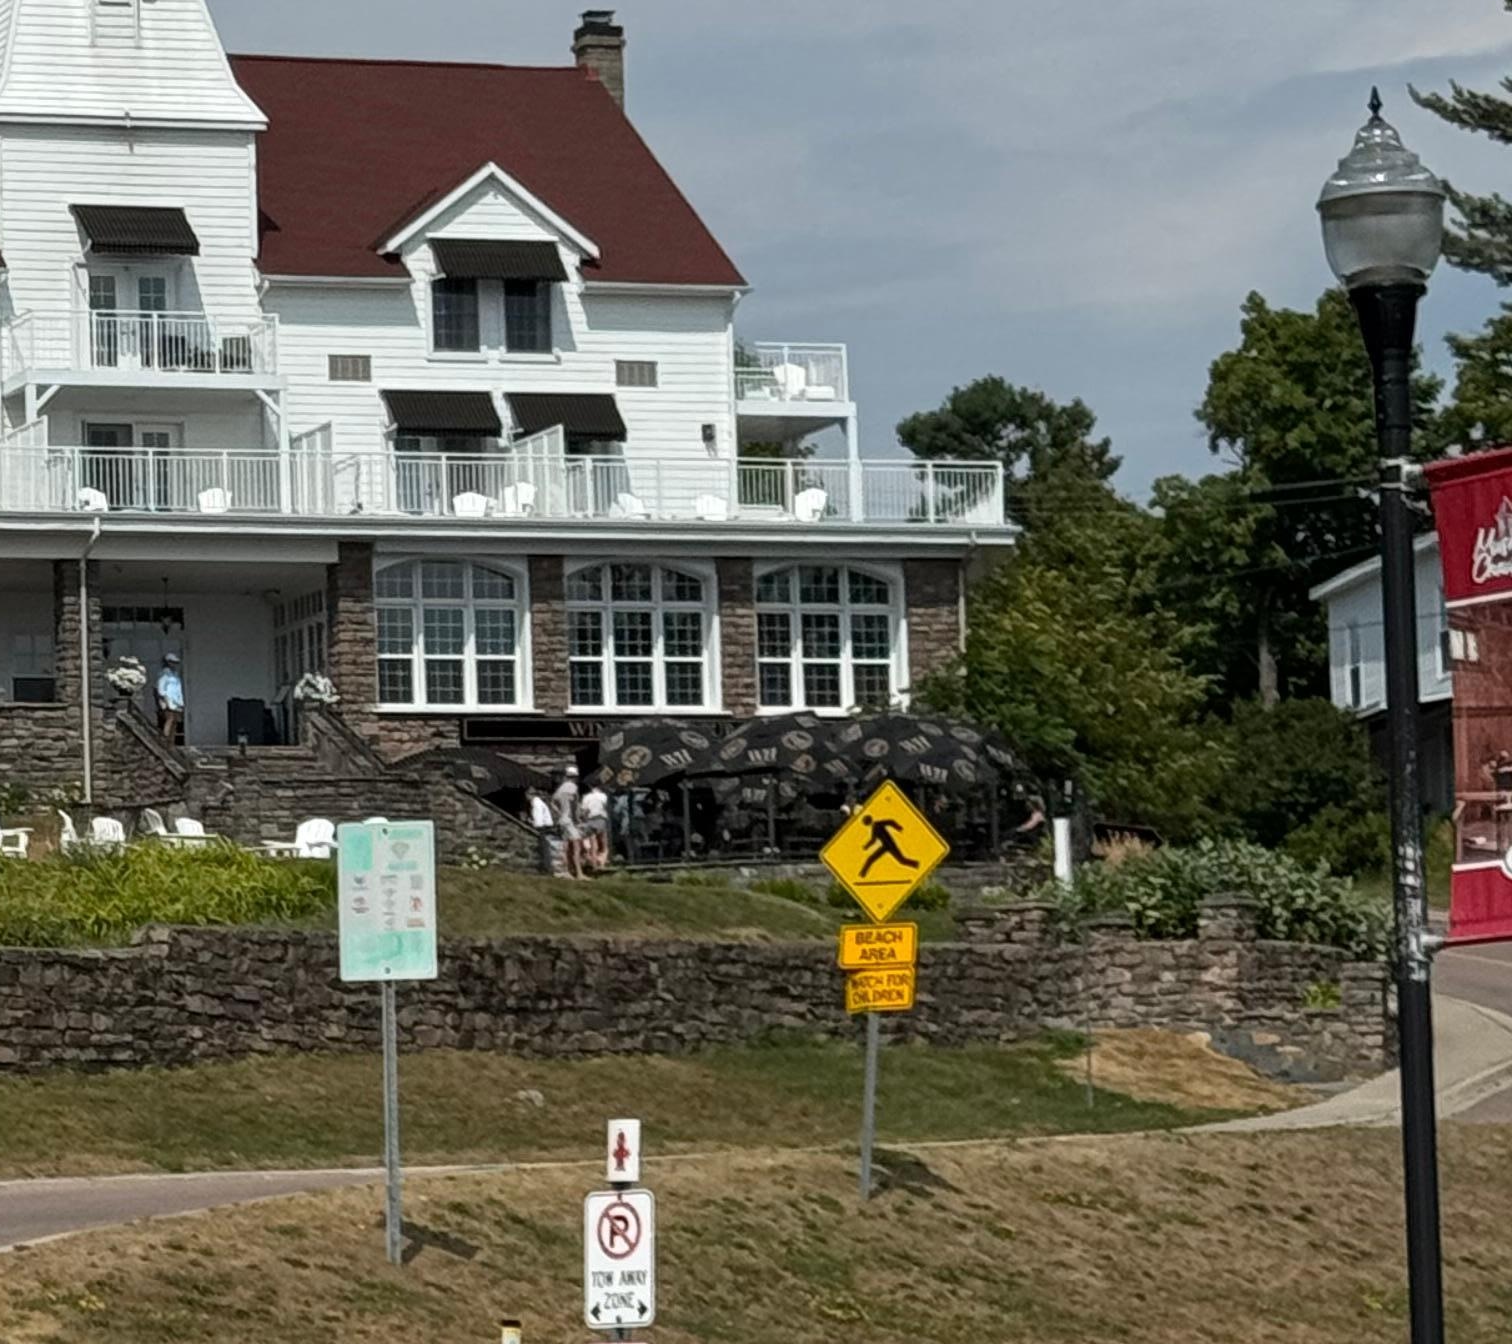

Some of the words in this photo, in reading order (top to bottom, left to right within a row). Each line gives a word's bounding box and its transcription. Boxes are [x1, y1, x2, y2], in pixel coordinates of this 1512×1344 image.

[855, 931, 903, 945] BEACH
[859, 946, 897, 960] AREA
[591, 1270, 614, 1288] TOW
[619, 1269, 648, 1286] AWAY
[604, 1292, 635, 1309] ZONE
